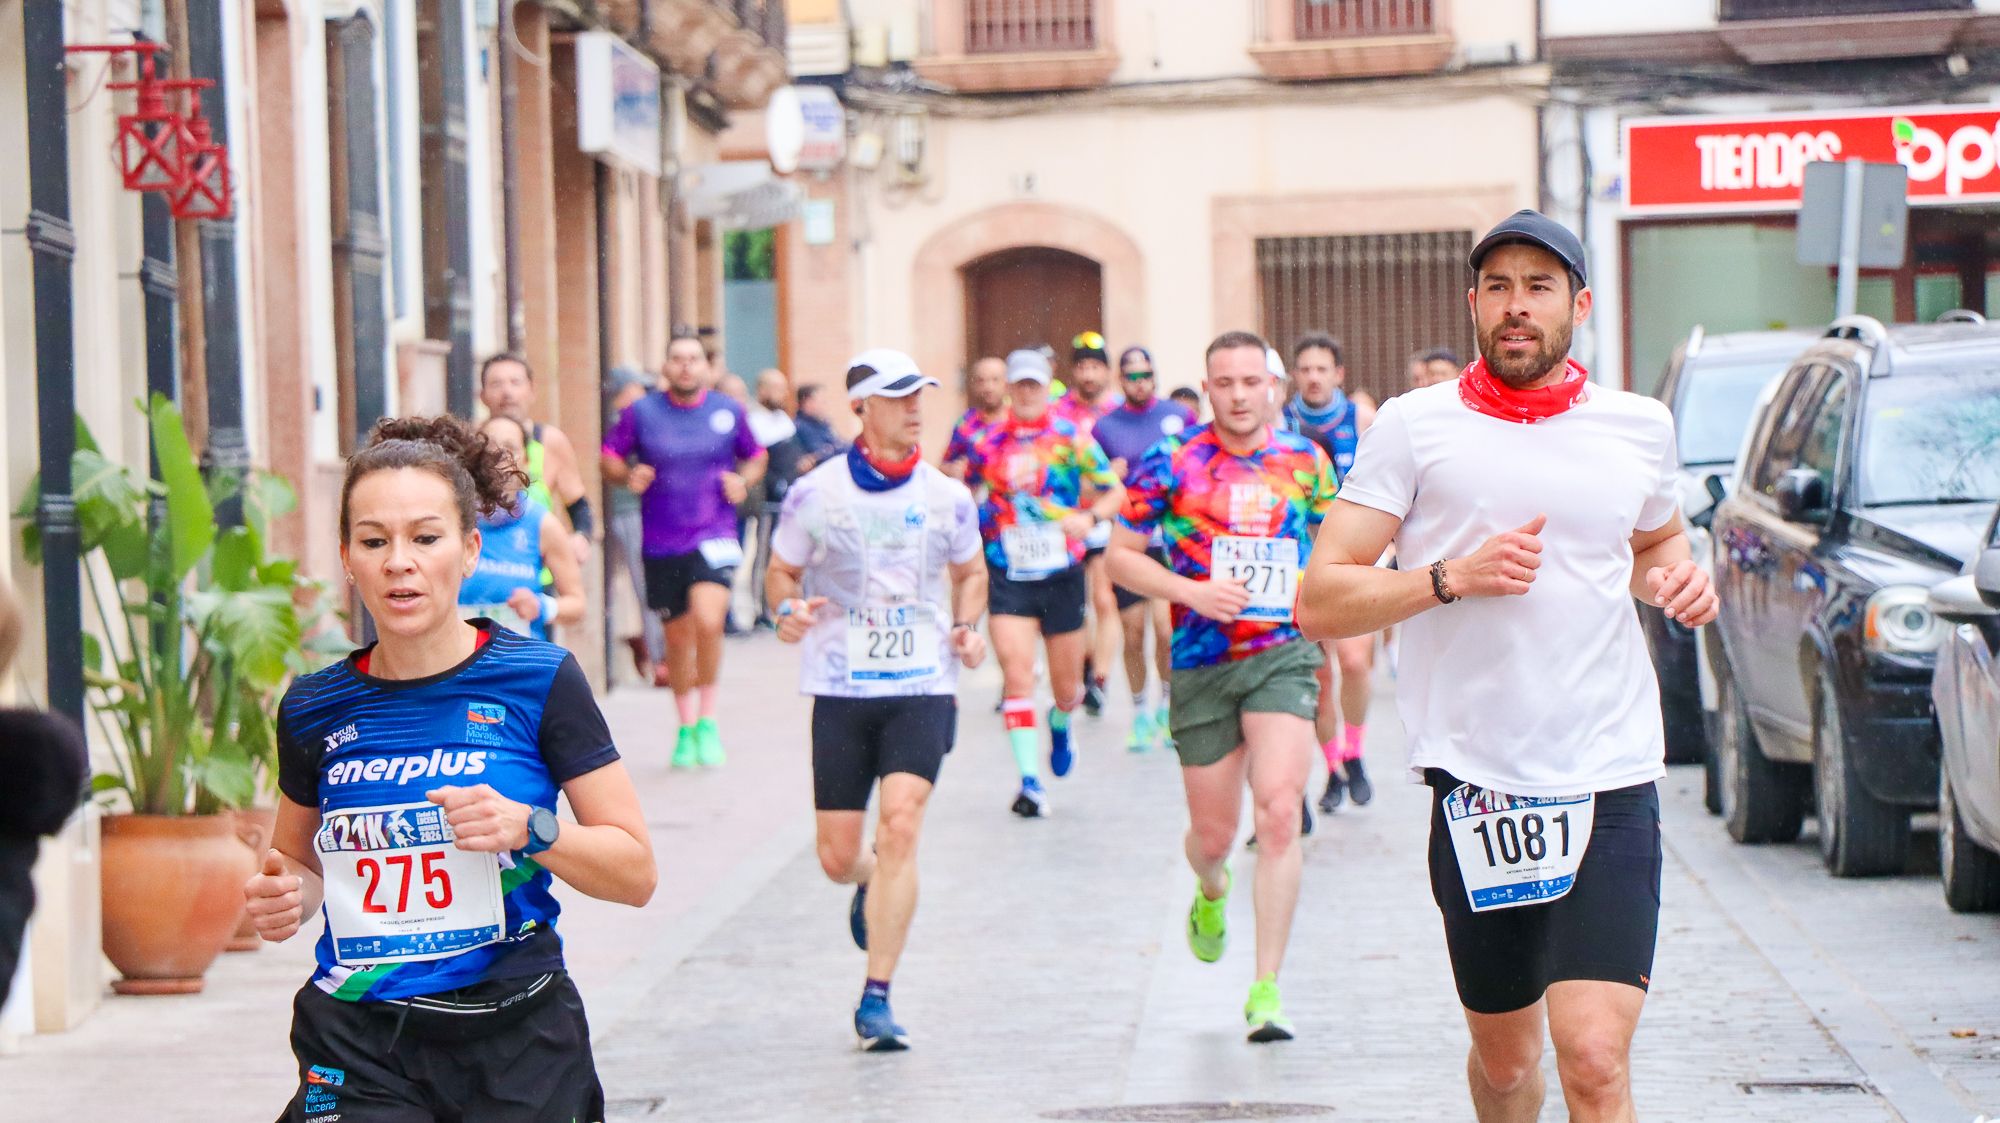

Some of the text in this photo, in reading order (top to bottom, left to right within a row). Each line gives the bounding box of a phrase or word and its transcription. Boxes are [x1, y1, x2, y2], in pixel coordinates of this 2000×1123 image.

[1695, 131, 1842, 190] TIENDAS
[1228, 565, 1287, 595] 1271
[868, 630, 914, 659] 220
[339, 731, 358, 745] PRO
[466, 722, 489, 731] Club
[327, 748, 487, 787] enerplus
[335, 813, 390, 850] 21K
[420, 830, 443, 843] 2026
[1472, 810, 1571, 868] 1081
[356, 851, 453, 914] 275
[305, 1101, 337, 1113] Lucena
